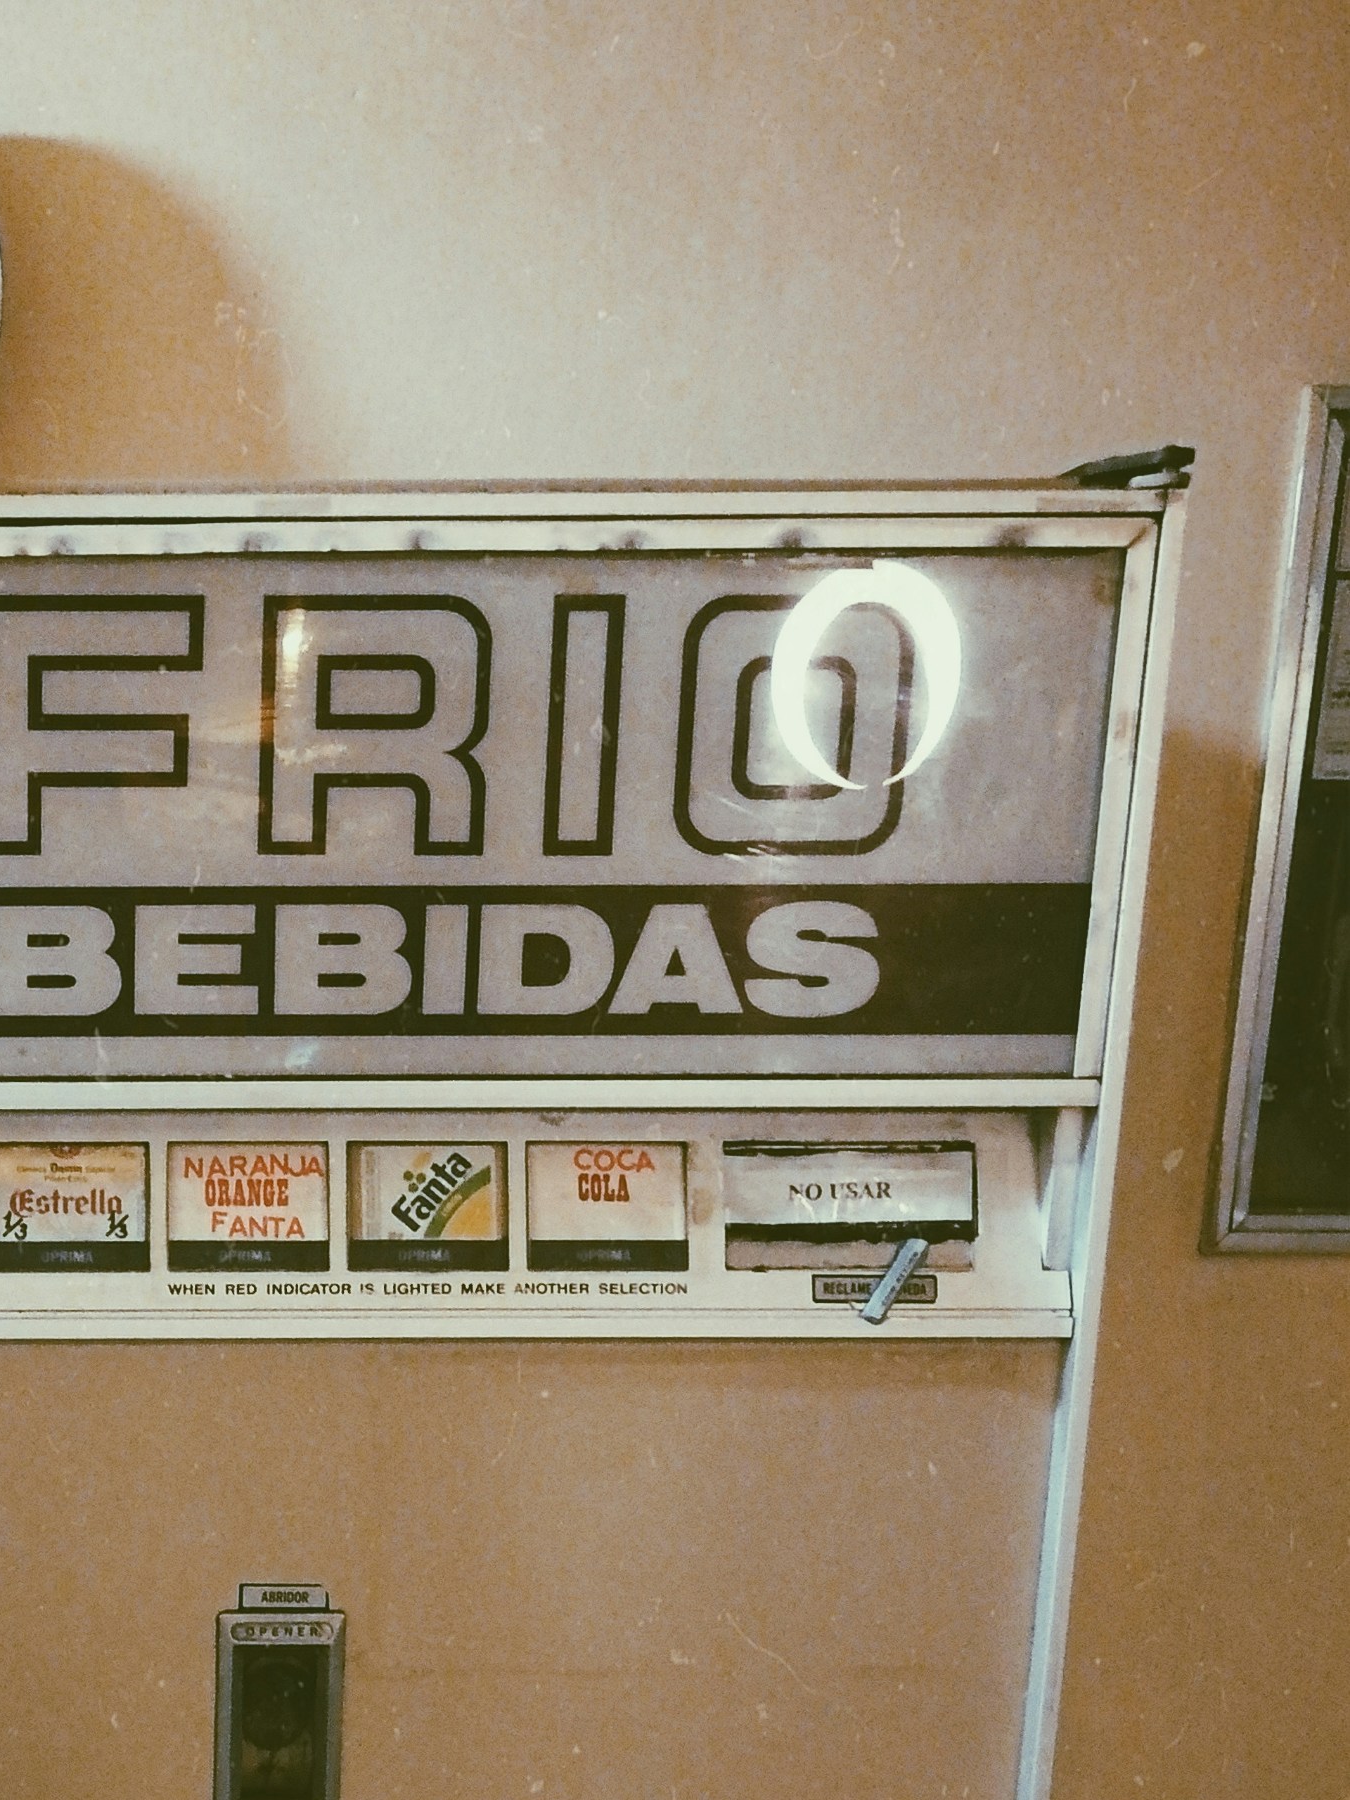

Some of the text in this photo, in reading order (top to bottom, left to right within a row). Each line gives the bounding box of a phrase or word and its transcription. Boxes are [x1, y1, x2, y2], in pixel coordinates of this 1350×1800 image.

[183, 1153, 325, 1178] NARANJA
[573, 1148, 656, 1173] COCA
[204, 1178, 289, 1207] ORANGE
[391, 1152, 473, 1232] Fanta
[577, 1173, 631, 1202] COLA
[788, 1181, 892, 1201] NO USAR
[9, 1188, 123, 1218] Estrella
[2, 1210, 28, 1240] 1/3
[105, 1210, 129, 1239] 1/3
[211, 1211, 306, 1239] FANTA
[167, 1282, 688, 1295] WHEN RED INDICATOR IS LIGHTED MAKE ANOTHER SELECTION
[823, 1282, 872, 1295] RECLAME
[261, 1591, 310, 1603] ABRIDOR
[245, 1626, 319, 1637] OPENER
